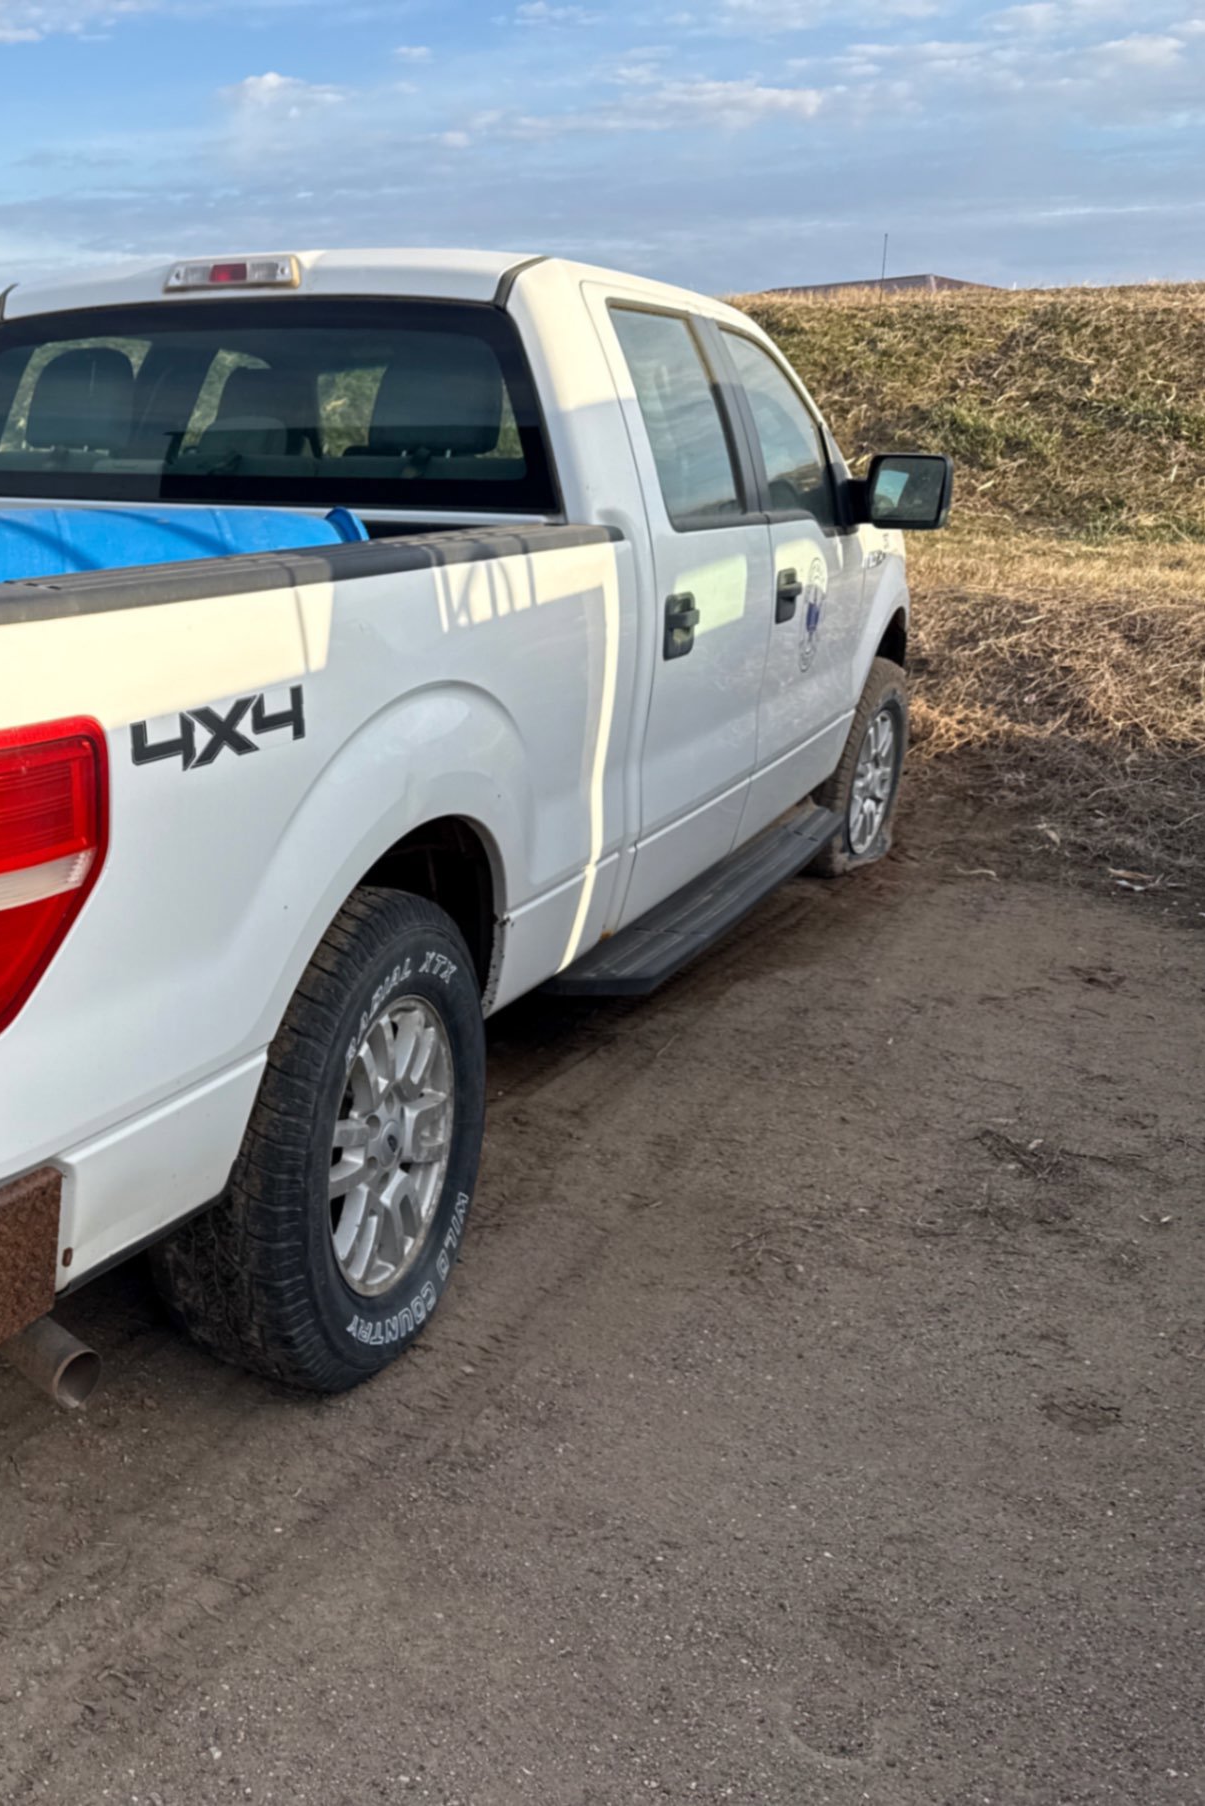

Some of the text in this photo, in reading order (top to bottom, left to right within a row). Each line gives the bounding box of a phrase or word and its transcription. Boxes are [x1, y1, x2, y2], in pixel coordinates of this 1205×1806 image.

[130, 684, 306, 772] 4X4
[418, 951, 458, 984] XTX
[345, 1191, 470, 1345] WILD COUNTRY
